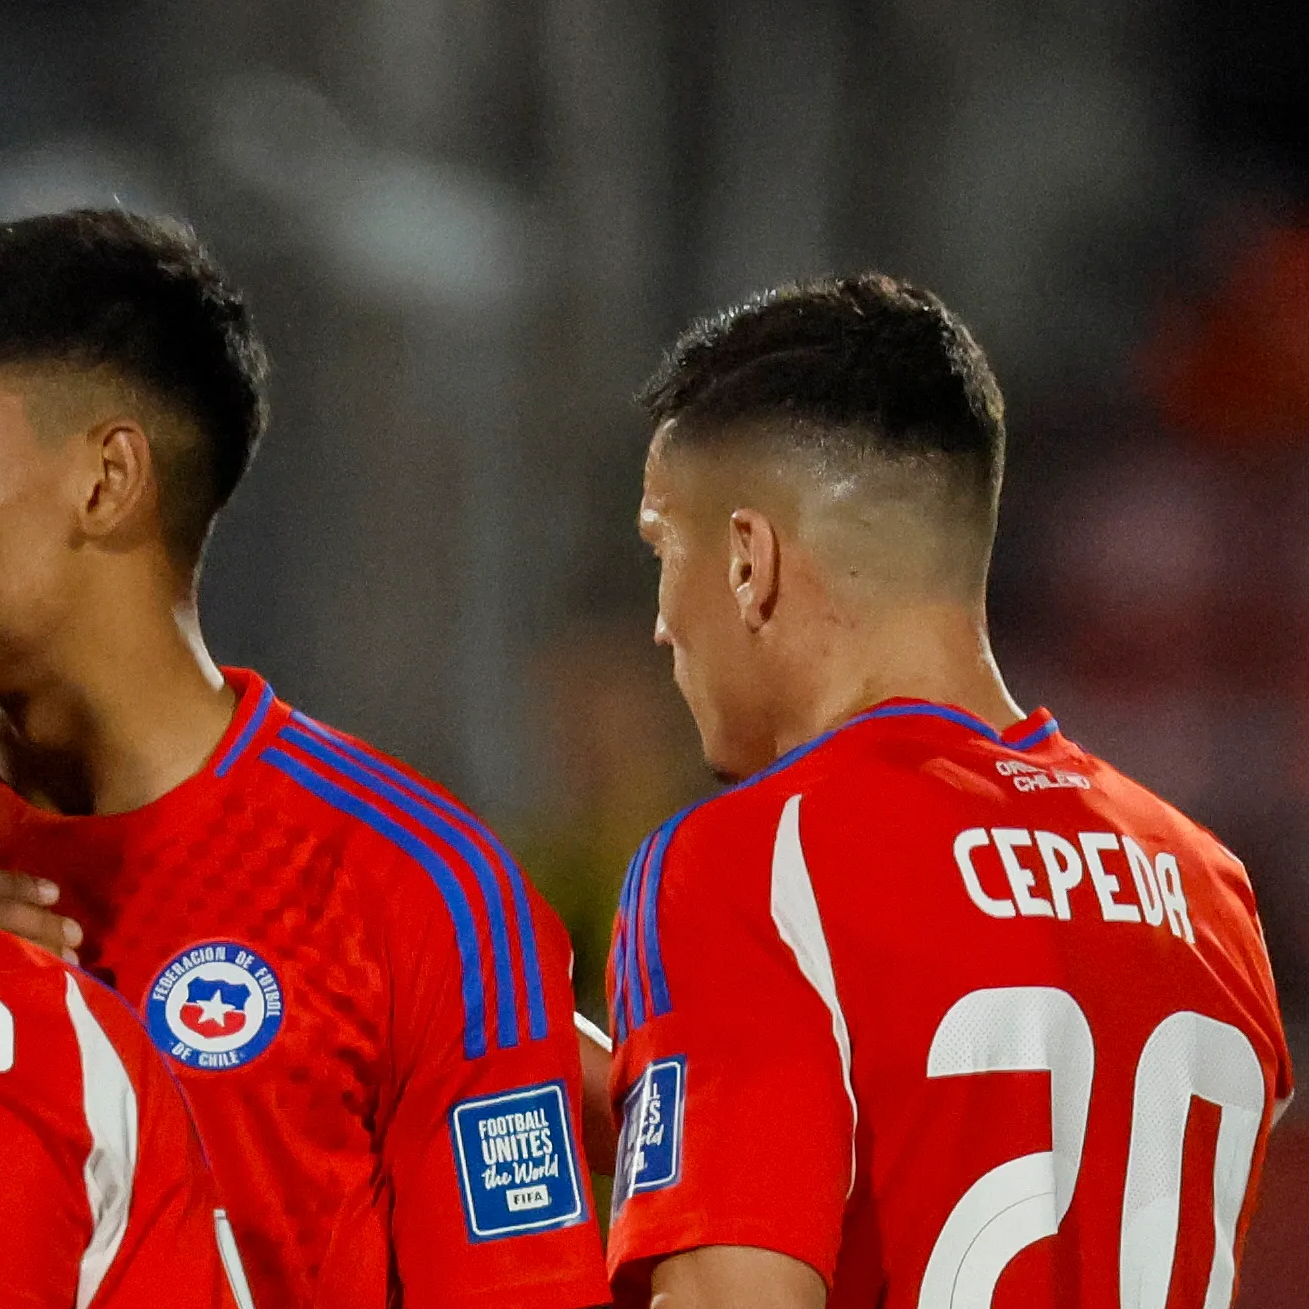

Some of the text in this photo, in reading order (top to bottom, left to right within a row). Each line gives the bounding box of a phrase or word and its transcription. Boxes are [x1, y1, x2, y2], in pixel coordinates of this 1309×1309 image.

[953, 827, 1195, 944] CEPEDA
[152, 946, 226, 1001] FEDERACION
[235, 951, 255, 969] DE
[171, 1042, 240, 1067] DE CHILE
[479, 1108, 549, 1139] FOOTBALL
[482, 1129, 553, 1165] UNITES
[482, 1154, 559, 1190] the World
[513, 1190, 544, 1205] FIFA
